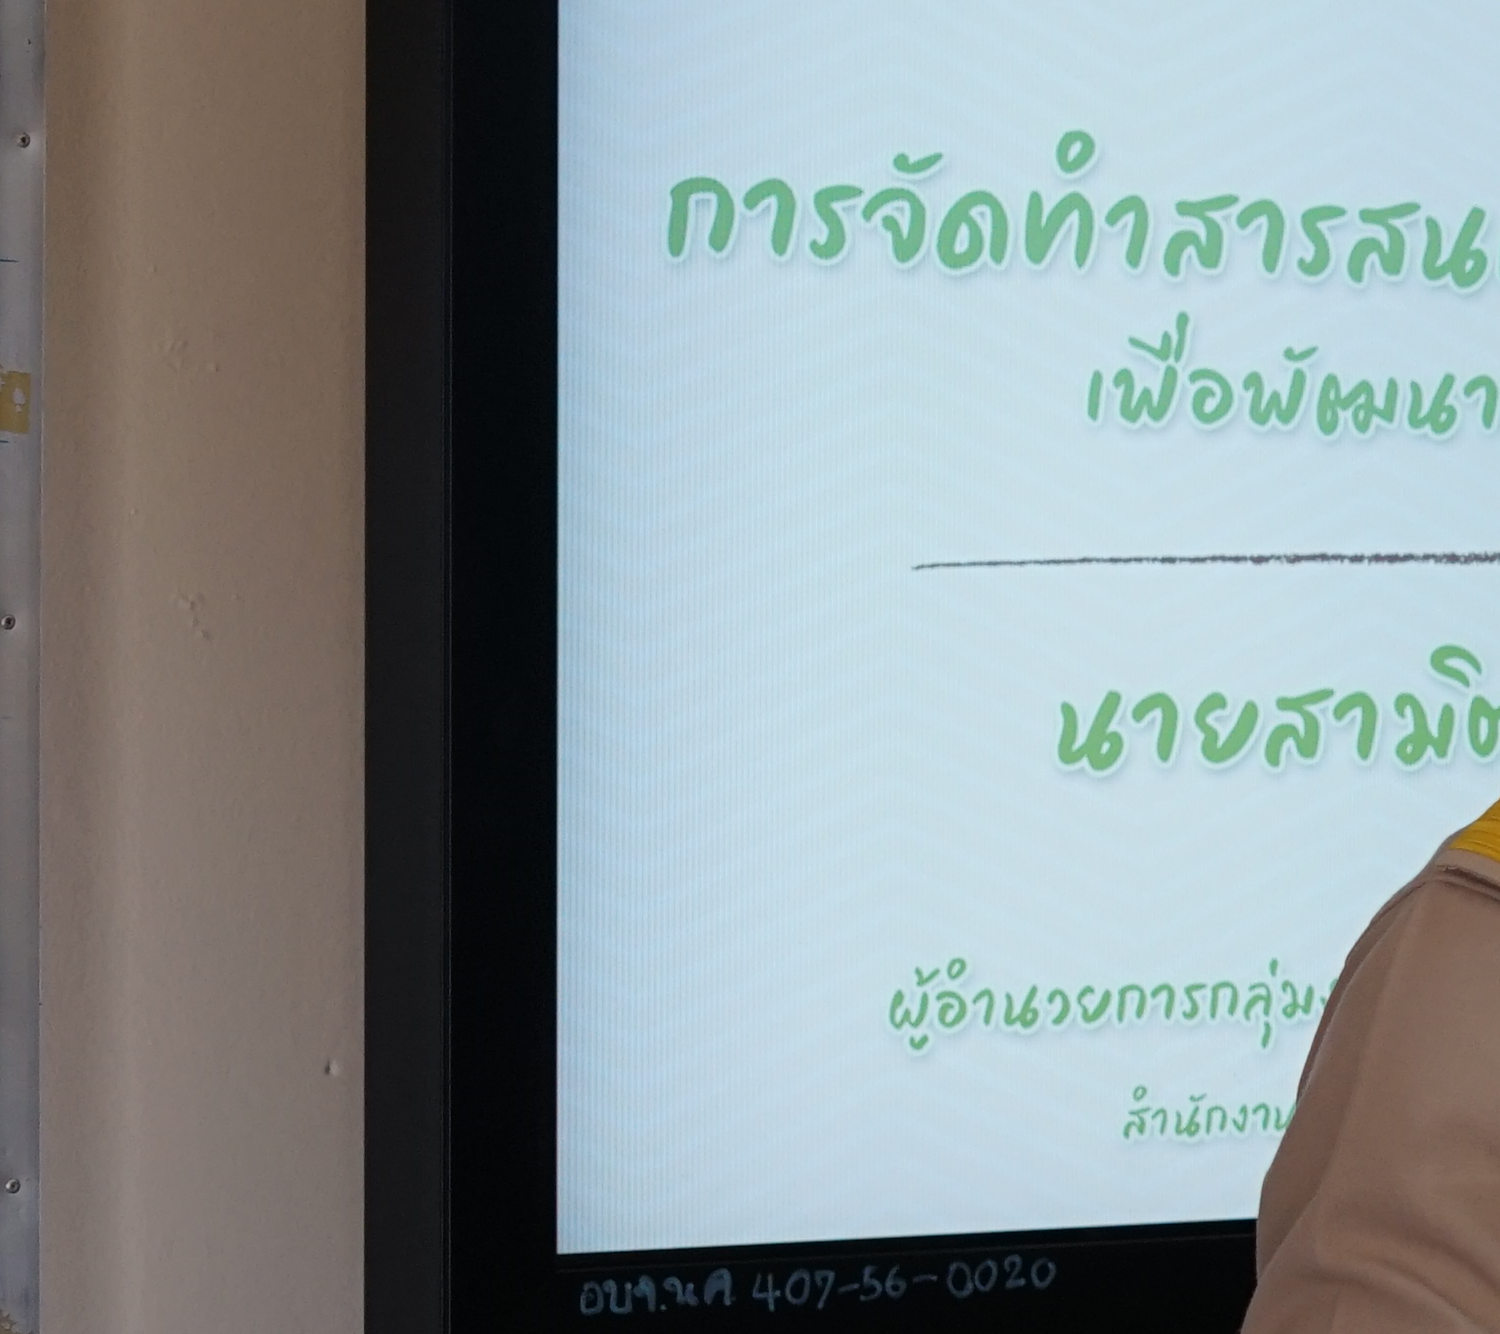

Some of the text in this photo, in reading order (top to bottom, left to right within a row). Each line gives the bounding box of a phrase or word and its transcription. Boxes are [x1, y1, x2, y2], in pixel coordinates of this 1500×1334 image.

[888, 957, 1340, 1051] ผู้อำนวยการกลุ่ม
[751, 1253, 1058, 1313] 407-56-0020
